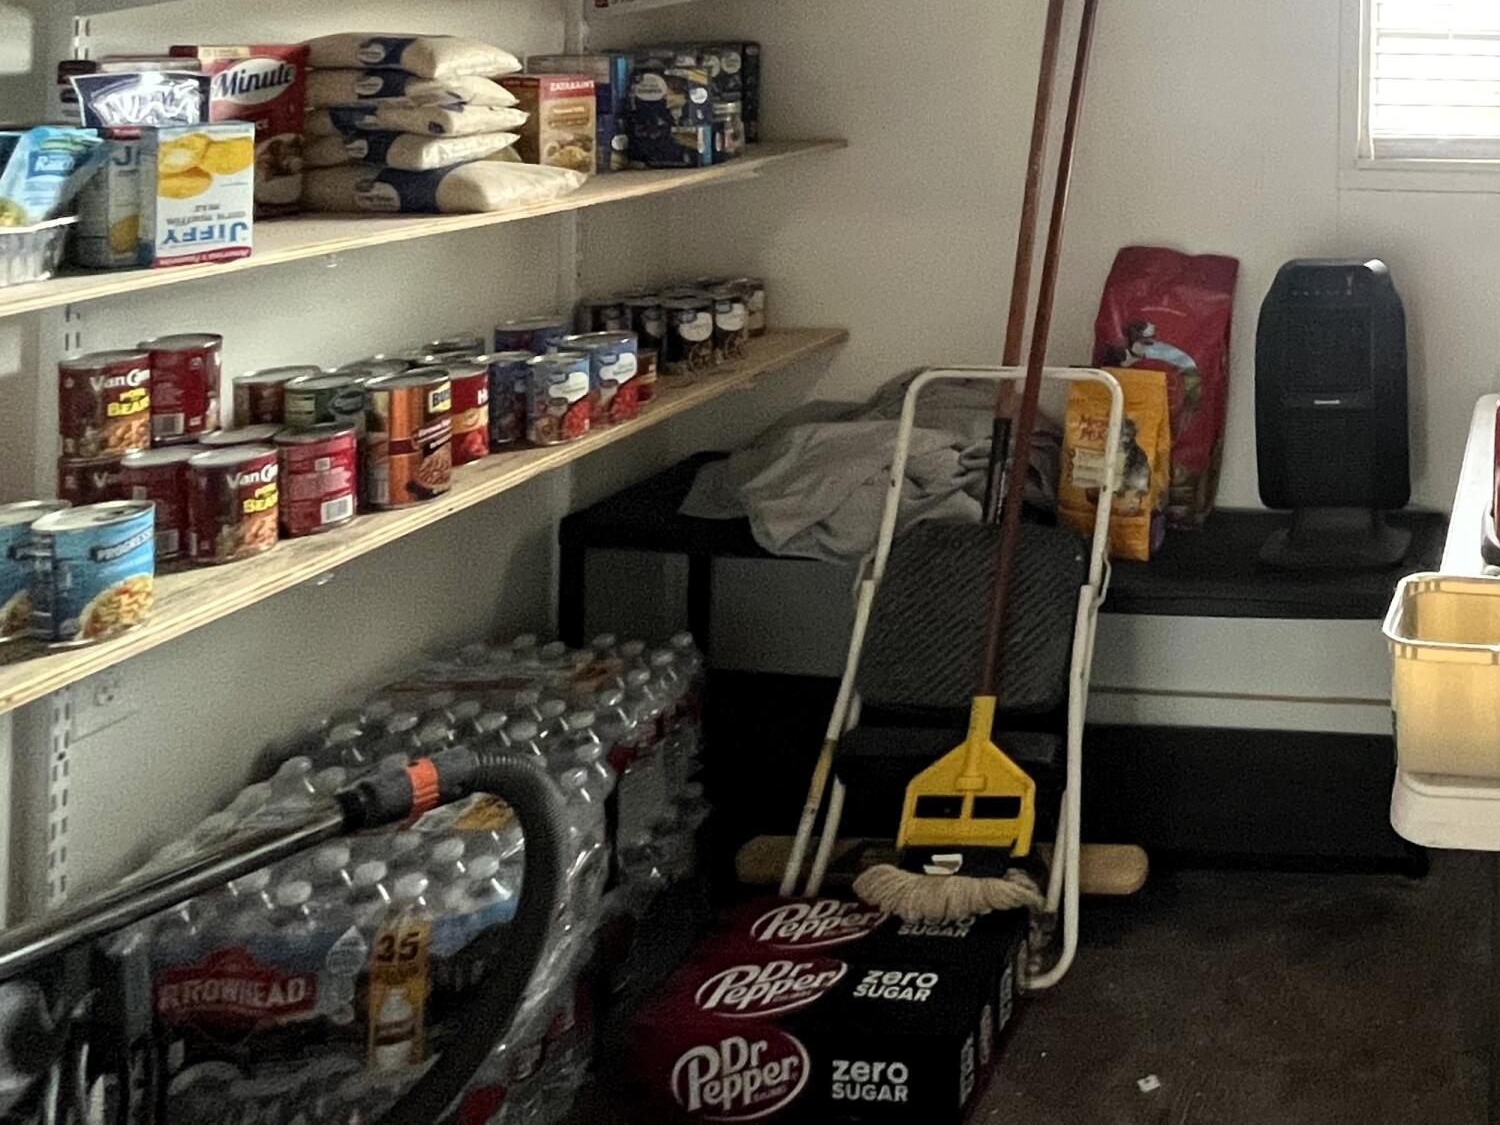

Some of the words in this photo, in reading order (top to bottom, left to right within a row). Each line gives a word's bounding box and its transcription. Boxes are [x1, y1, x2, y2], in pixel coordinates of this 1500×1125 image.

[213, 62, 295, 98] Minute
[757, 903, 884, 943] Pepper
[808, 900, 858, 918] Dr
[377, 932, 420, 962] 35
[757, 960, 813, 980] Dr
[861, 969, 939, 989] zero
[702, 965, 839, 1010] Pepper
[852, 983, 932, 1002] SUGAR
[720, 1035, 768, 1076] Dr
[687, 1045, 801, 1113] Pepper
[831, 1059, 910, 1085] zero
[831, 1084, 909, 1103] SUGAR
